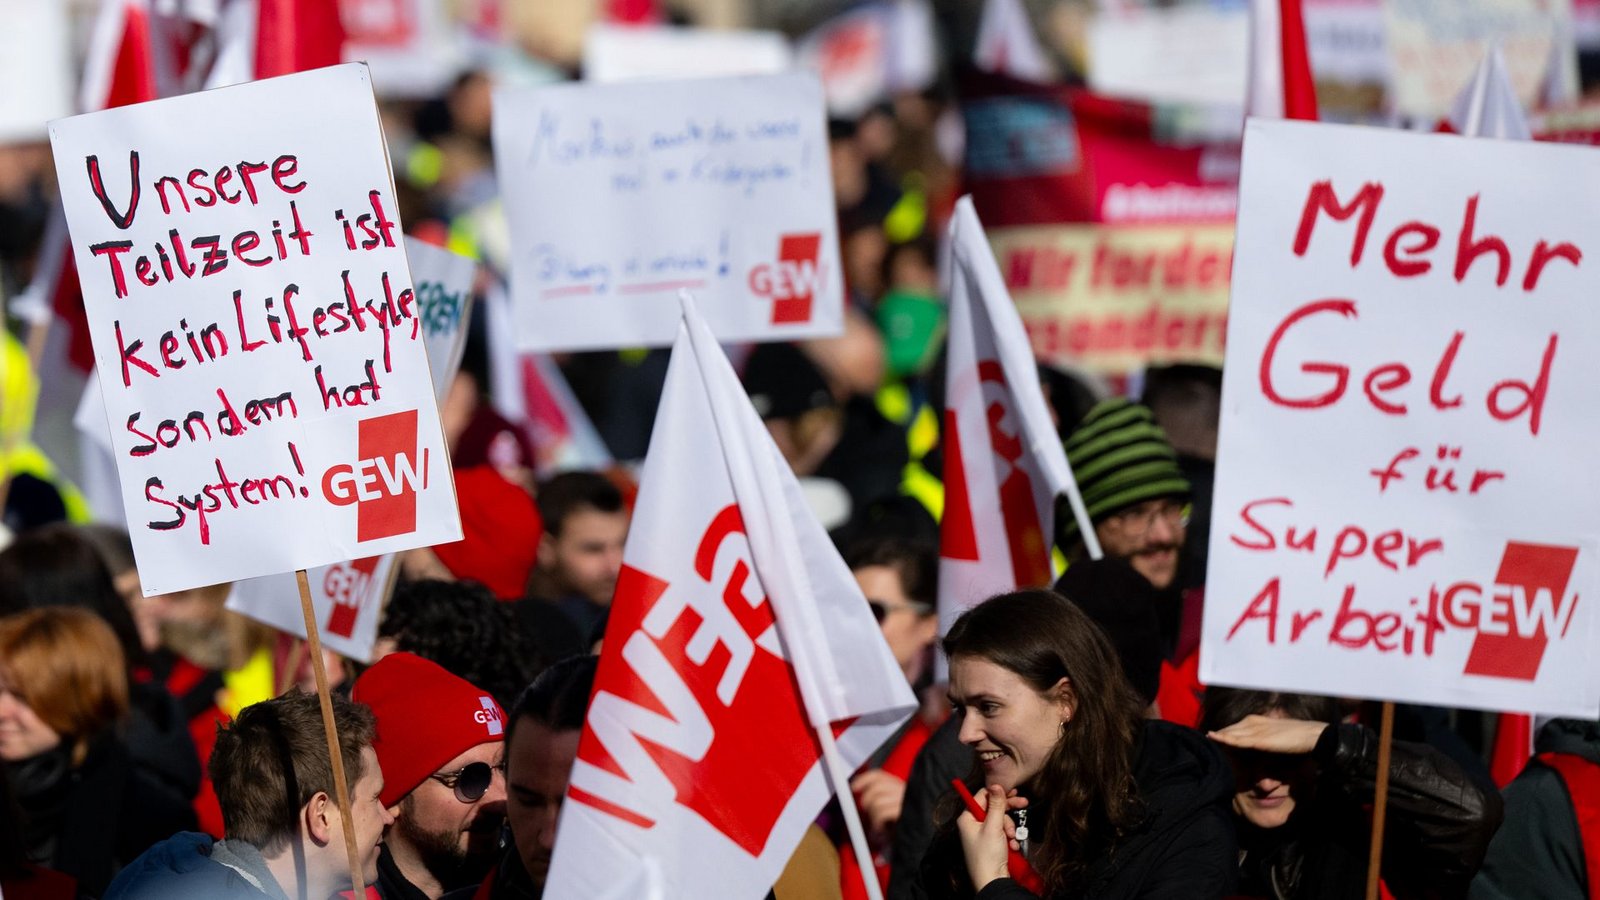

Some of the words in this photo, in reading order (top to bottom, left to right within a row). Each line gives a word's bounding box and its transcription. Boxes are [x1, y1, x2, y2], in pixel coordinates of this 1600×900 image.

[85, 150, 307, 229] Unsere
[88, 200, 314, 299] Teilzeit
[335, 189, 395, 251] ist
[1292, 179, 1582, 292] Mehr
[747, 258, 823, 300] GEW
[114, 318, 230, 388] kein
[232, 270, 418, 373] Lifestyle,
[1259, 299, 1558, 435] Geld
[315, 359, 381, 411] hat
[145, 441, 309, 545] System!
[321, 449, 423, 507] GEW
[1370, 444, 1506, 494] für
[1230, 497, 1443, 579] Super
[324, 565, 369, 609] GEW
[1225, 577, 1445, 657] Arbeit
[1442, 581, 1572, 640] GEW
[473, 706, 502, 725] GEW
